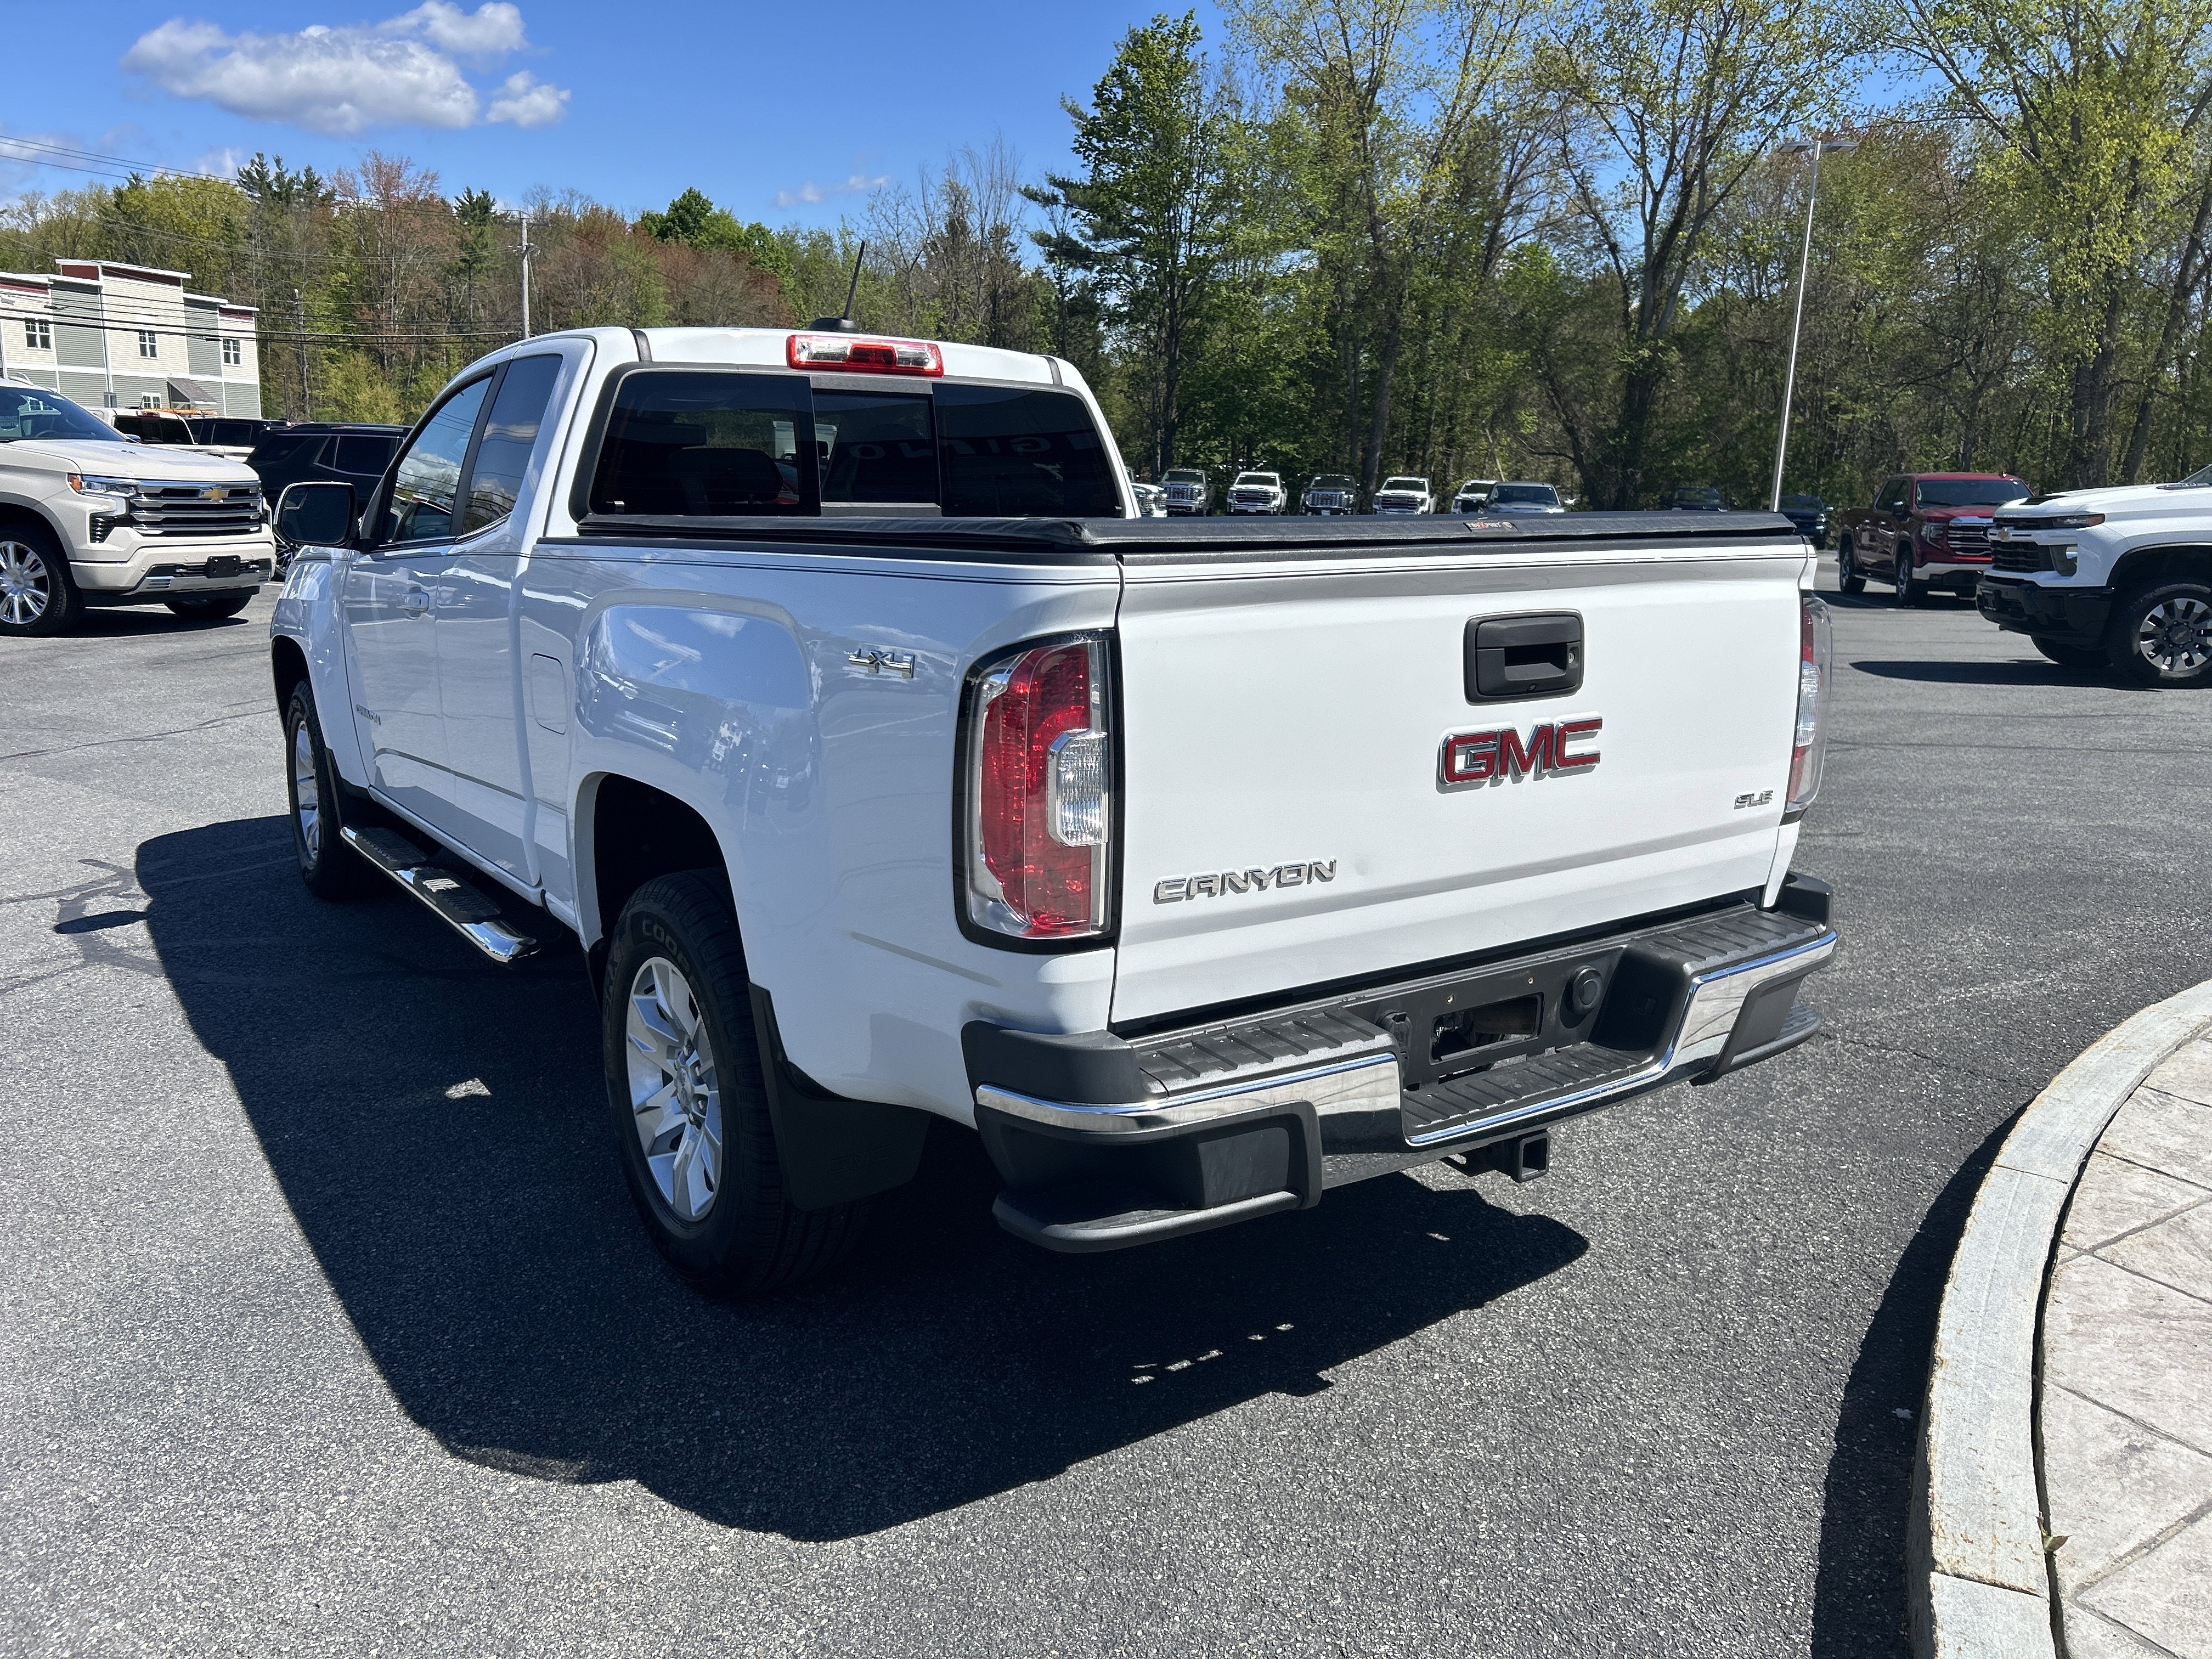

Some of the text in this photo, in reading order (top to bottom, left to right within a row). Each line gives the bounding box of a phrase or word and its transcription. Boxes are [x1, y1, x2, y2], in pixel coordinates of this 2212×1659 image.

[1437, 715, 1602, 786] GMC
[1734, 790, 1773, 810] SLE
[1153, 858, 1337, 902] CANYON
